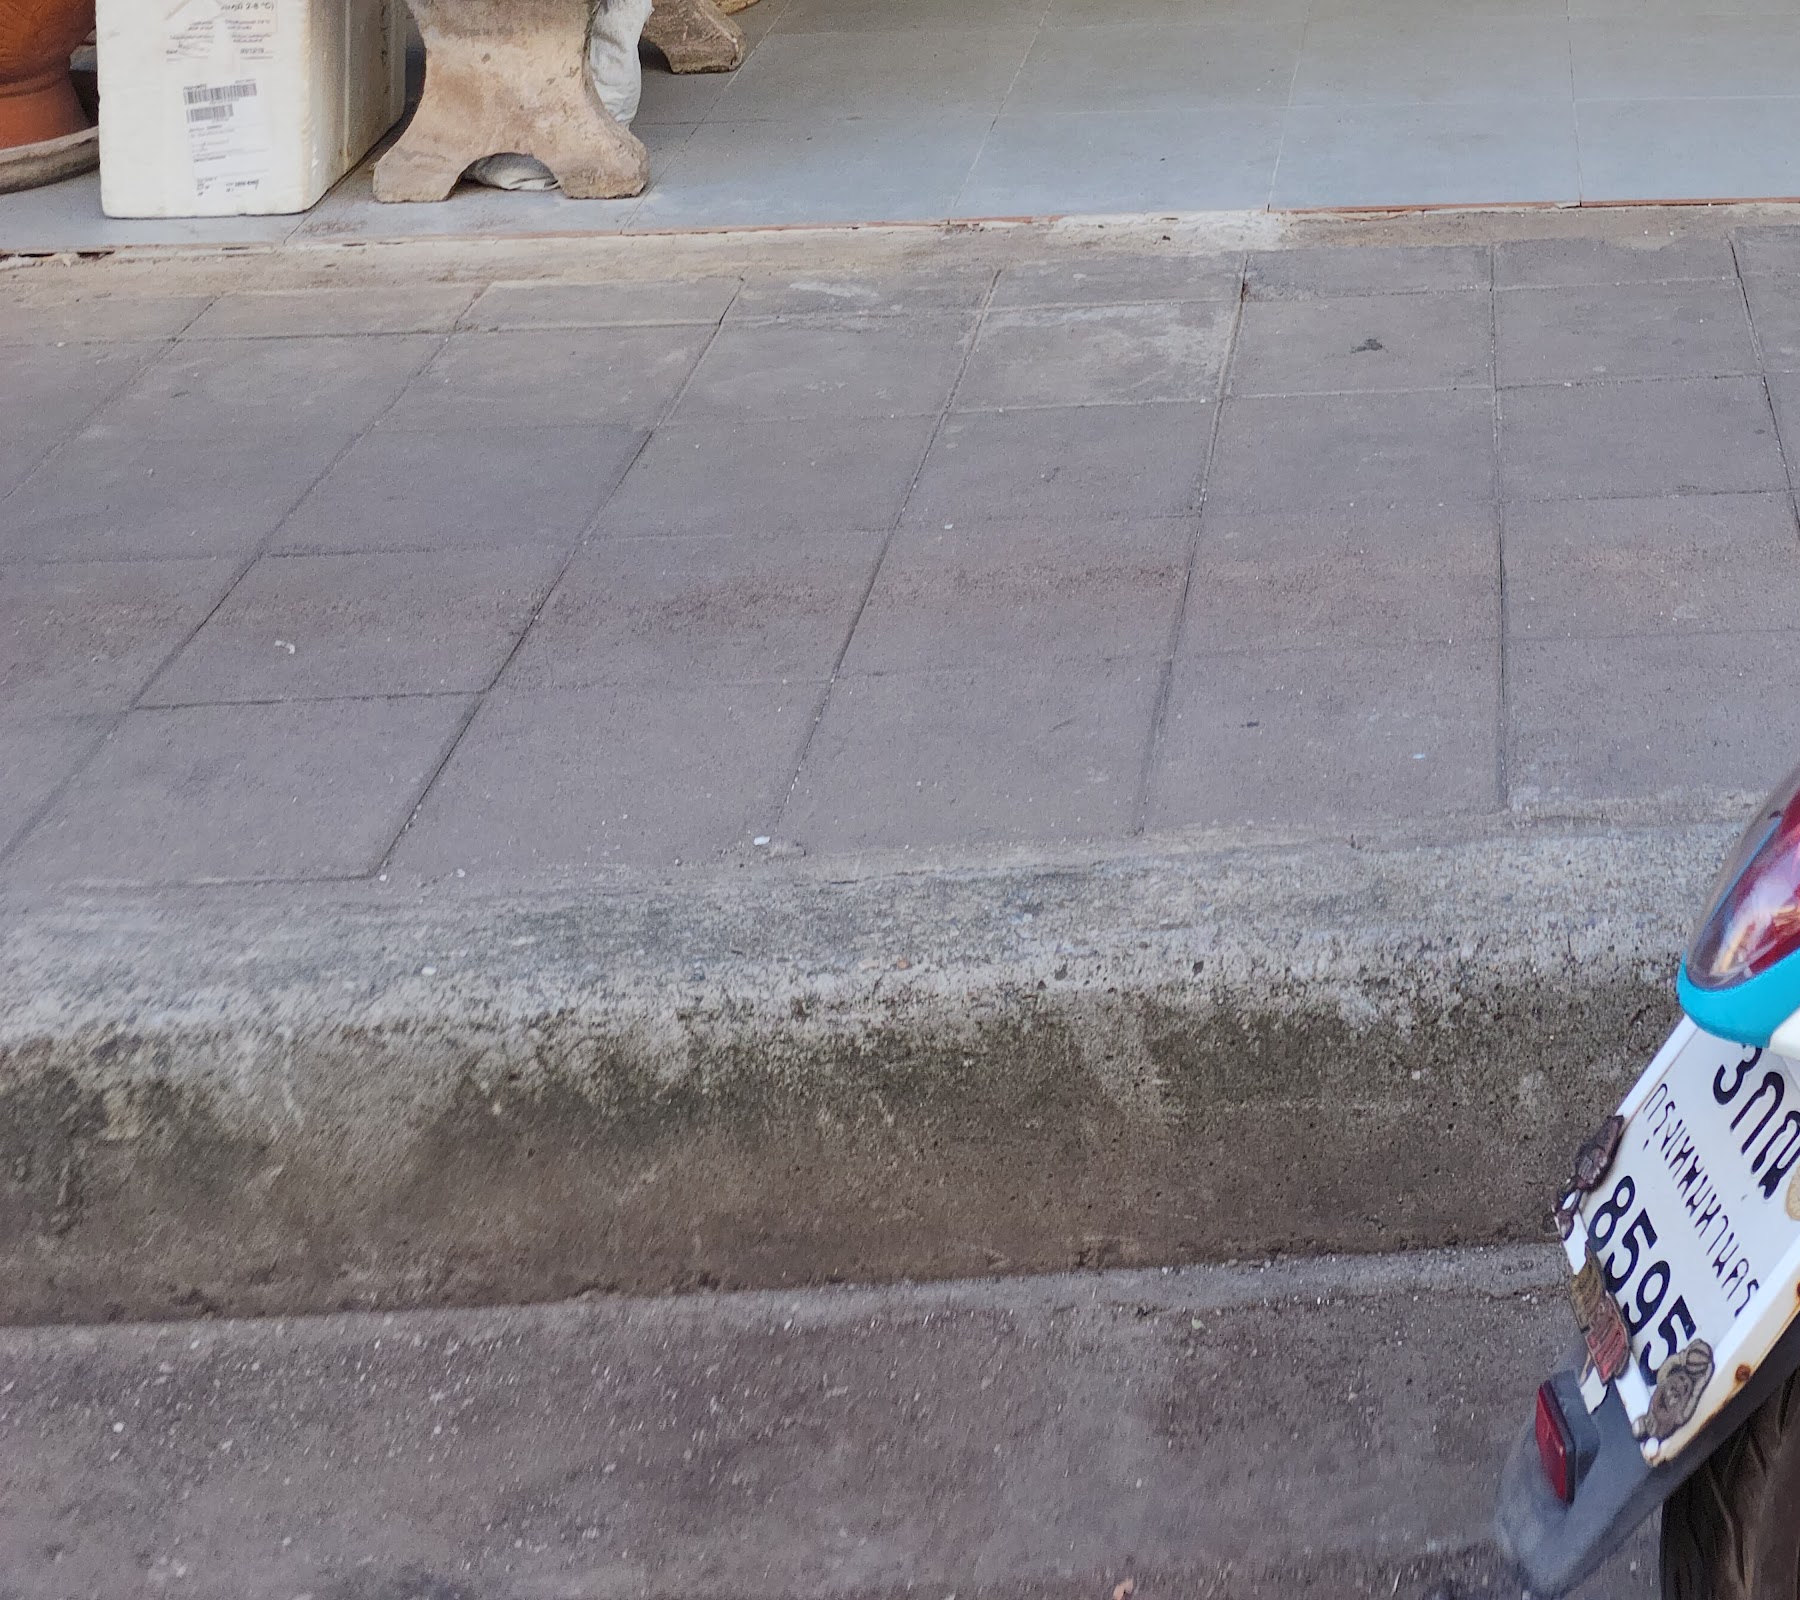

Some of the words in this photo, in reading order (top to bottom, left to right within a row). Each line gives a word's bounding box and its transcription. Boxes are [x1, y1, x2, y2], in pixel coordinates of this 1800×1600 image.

[1587, 1175, 1698, 1387] 8595
[1643, 1081, 1761, 1318] กรุงเทพมหานคร
